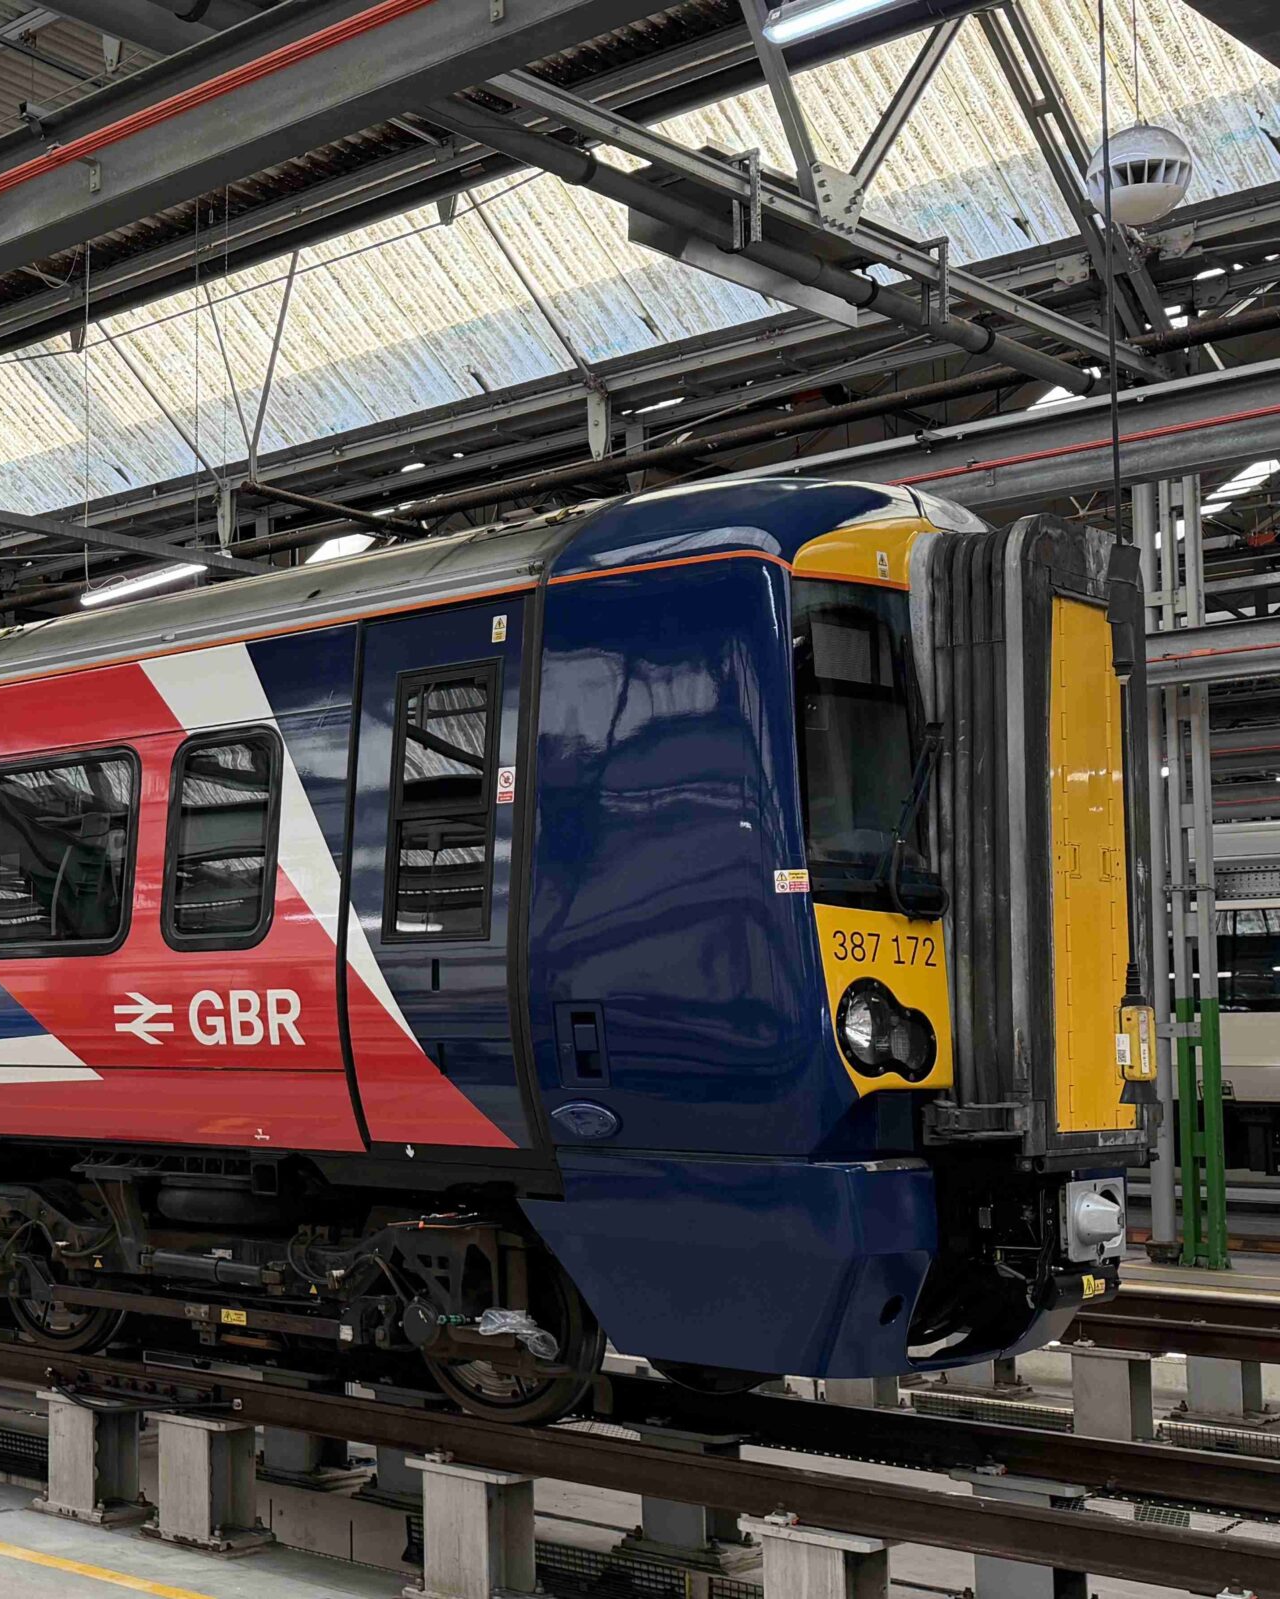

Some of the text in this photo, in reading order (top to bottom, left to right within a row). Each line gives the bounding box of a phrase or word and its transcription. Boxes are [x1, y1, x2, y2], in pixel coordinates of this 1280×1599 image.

[832, 930, 937, 967] 387 172
[188, 988, 306, 1046] GBR
